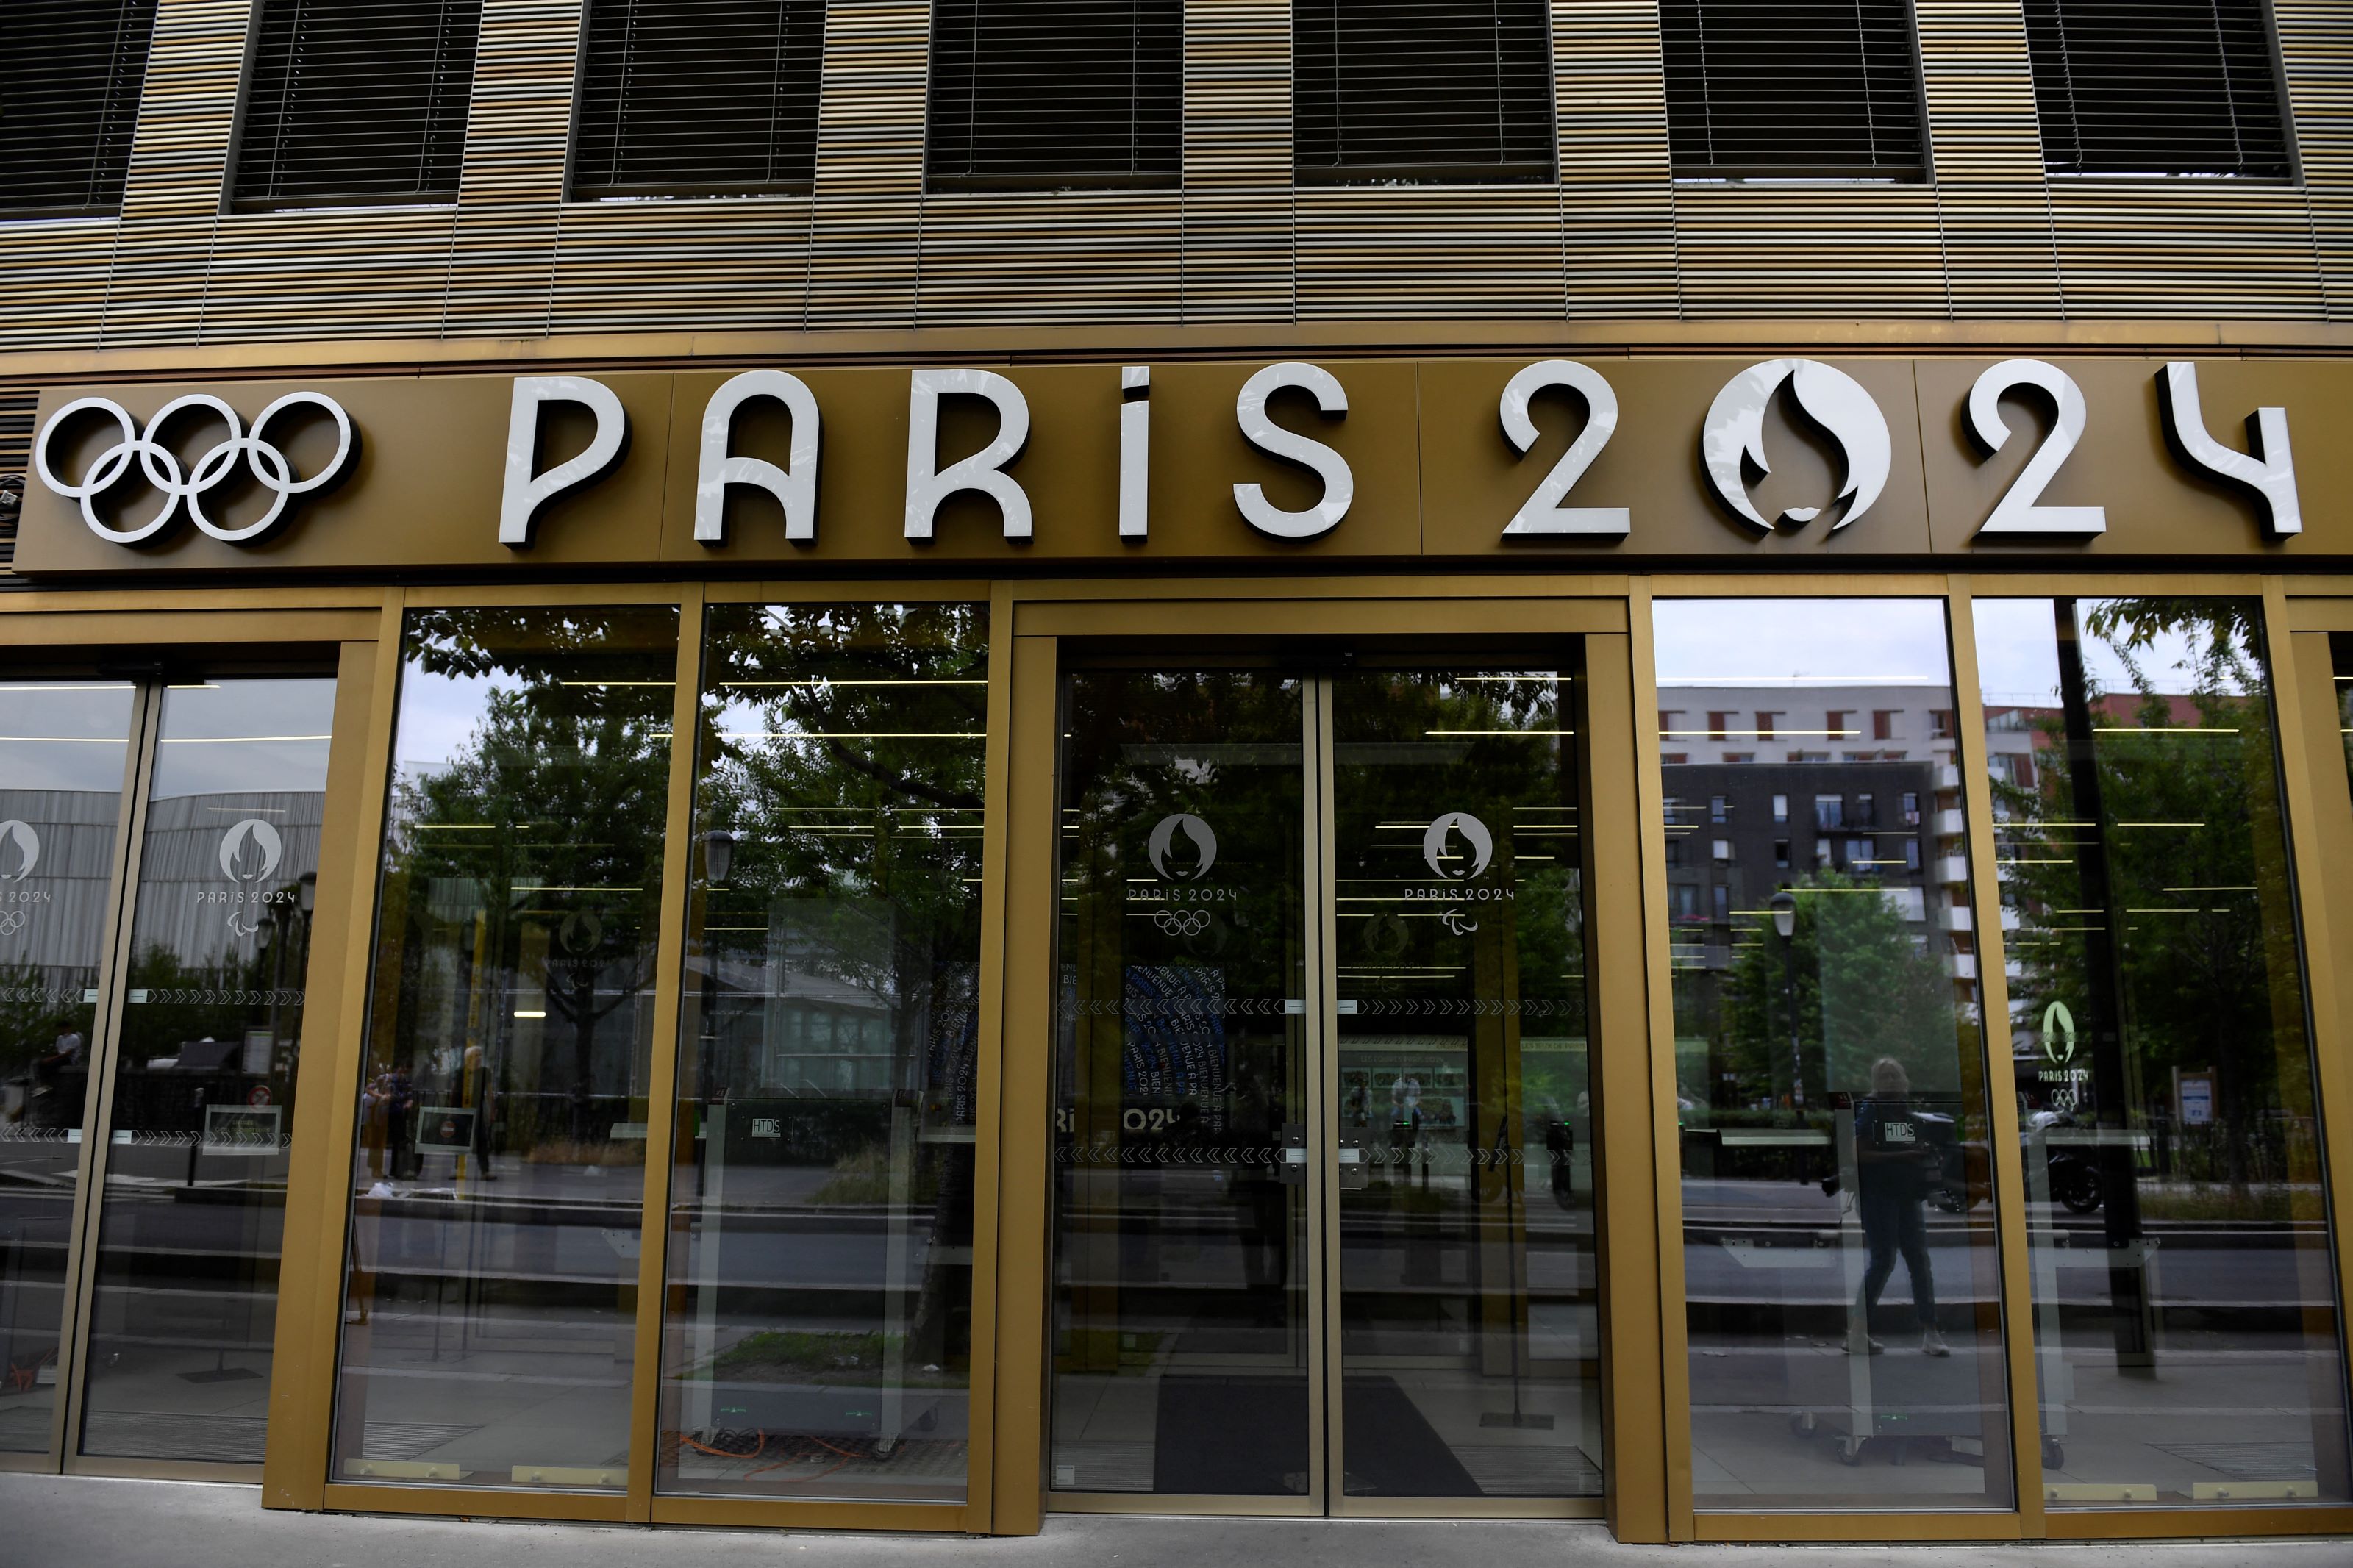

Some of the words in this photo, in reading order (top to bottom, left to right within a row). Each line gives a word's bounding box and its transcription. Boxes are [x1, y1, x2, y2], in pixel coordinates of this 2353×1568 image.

[1499, 357, 2303, 539] 2024
[8, 891, 51, 903] 2024
[251, 891, 296, 903] 2024
[1188, 889, 1237, 901] 2024
[1465, 888, 1515, 901] 2024
[2063, 1069, 2088, 1082] 2024
[753, 1119, 781, 1133] HTDS
[1886, 1123, 1915, 1136] HTDS
